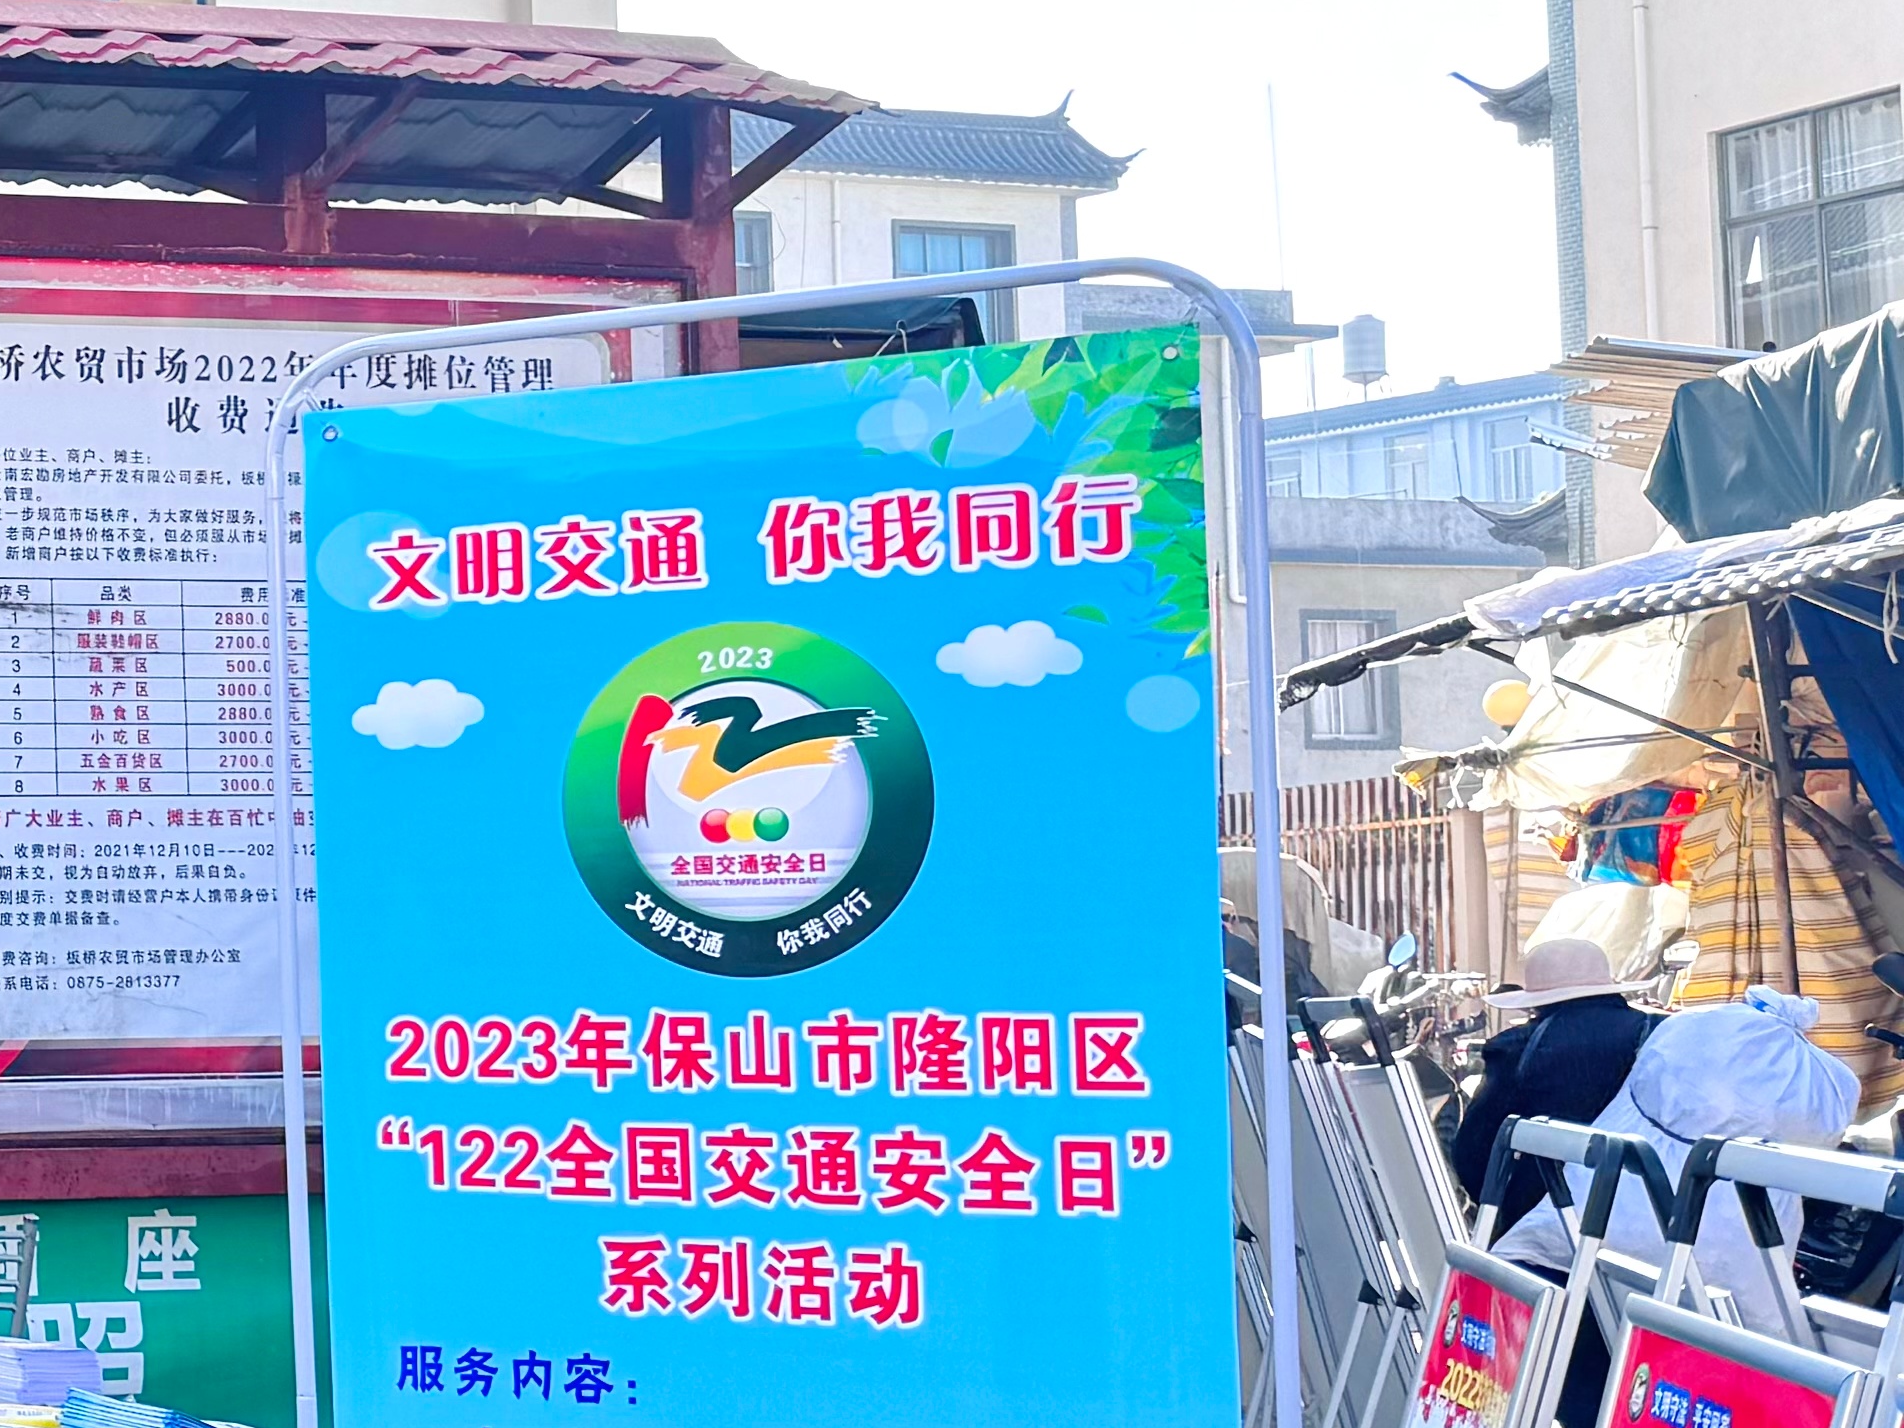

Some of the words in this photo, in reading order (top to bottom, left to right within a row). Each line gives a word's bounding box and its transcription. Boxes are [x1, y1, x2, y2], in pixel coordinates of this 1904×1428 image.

[370, 510, 706, 608] 文明交通
[759, 474, 1141, 581] 你我同行
[100, 585, 132, 601] 品类
[240, 586, 306, 603] 费用准
[12, 612, 18, 625] 1
[11, 636, 20, 649] 2
[12, 659, 21, 673] 3
[697, 646, 774, 674] 2023
[12, 683, 21, 697] 4
[89, 681, 149, 697] 水产区
[13, 708, 22, 721] 5
[14, 731, 23, 745] 6
[91, 729, 151, 745] 小吃区
[14, 756, 23, 769] 7
[80, 753, 163, 770] 五金百货区
[14, 780, 24, 794] 8
[92, 778, 152, 794] 水果区
[670, 853, 826, 876] 全国交通安全日
[625, 891, 726, 959] 文明交通
[776, 887, 873, 956] 你我同行
[384, 1011, 1150, 1095] 2023年保山市隆阳区
[378, 1117, 1172, 1216] “122全国交通安全日”
[599, 1237, 925, 1327] 系列活动
[396, 1344, 640, 1406] 服务内容：
